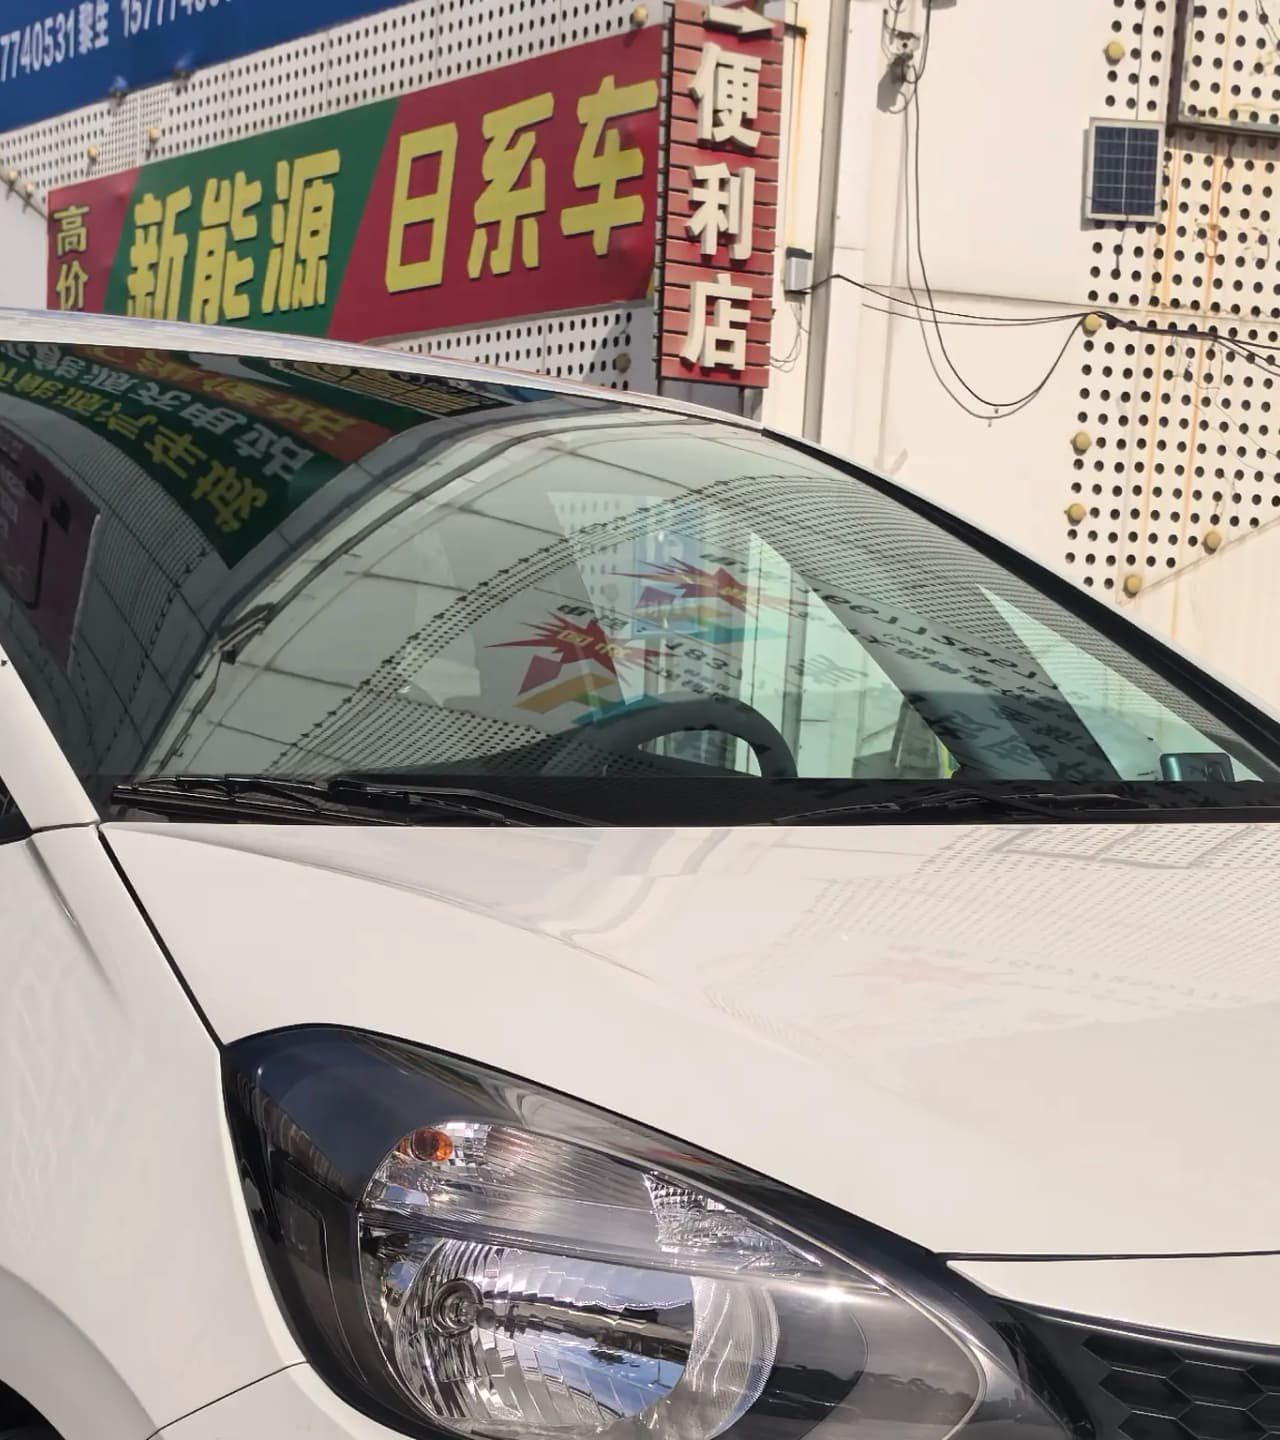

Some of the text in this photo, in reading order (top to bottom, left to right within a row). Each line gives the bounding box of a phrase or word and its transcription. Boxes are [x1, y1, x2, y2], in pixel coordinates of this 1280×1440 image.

[53, 204, 90, 312] 高价
[126, 75, 659, 325] 新能源 日系车
[679, 42, 762, 372] 便利店
